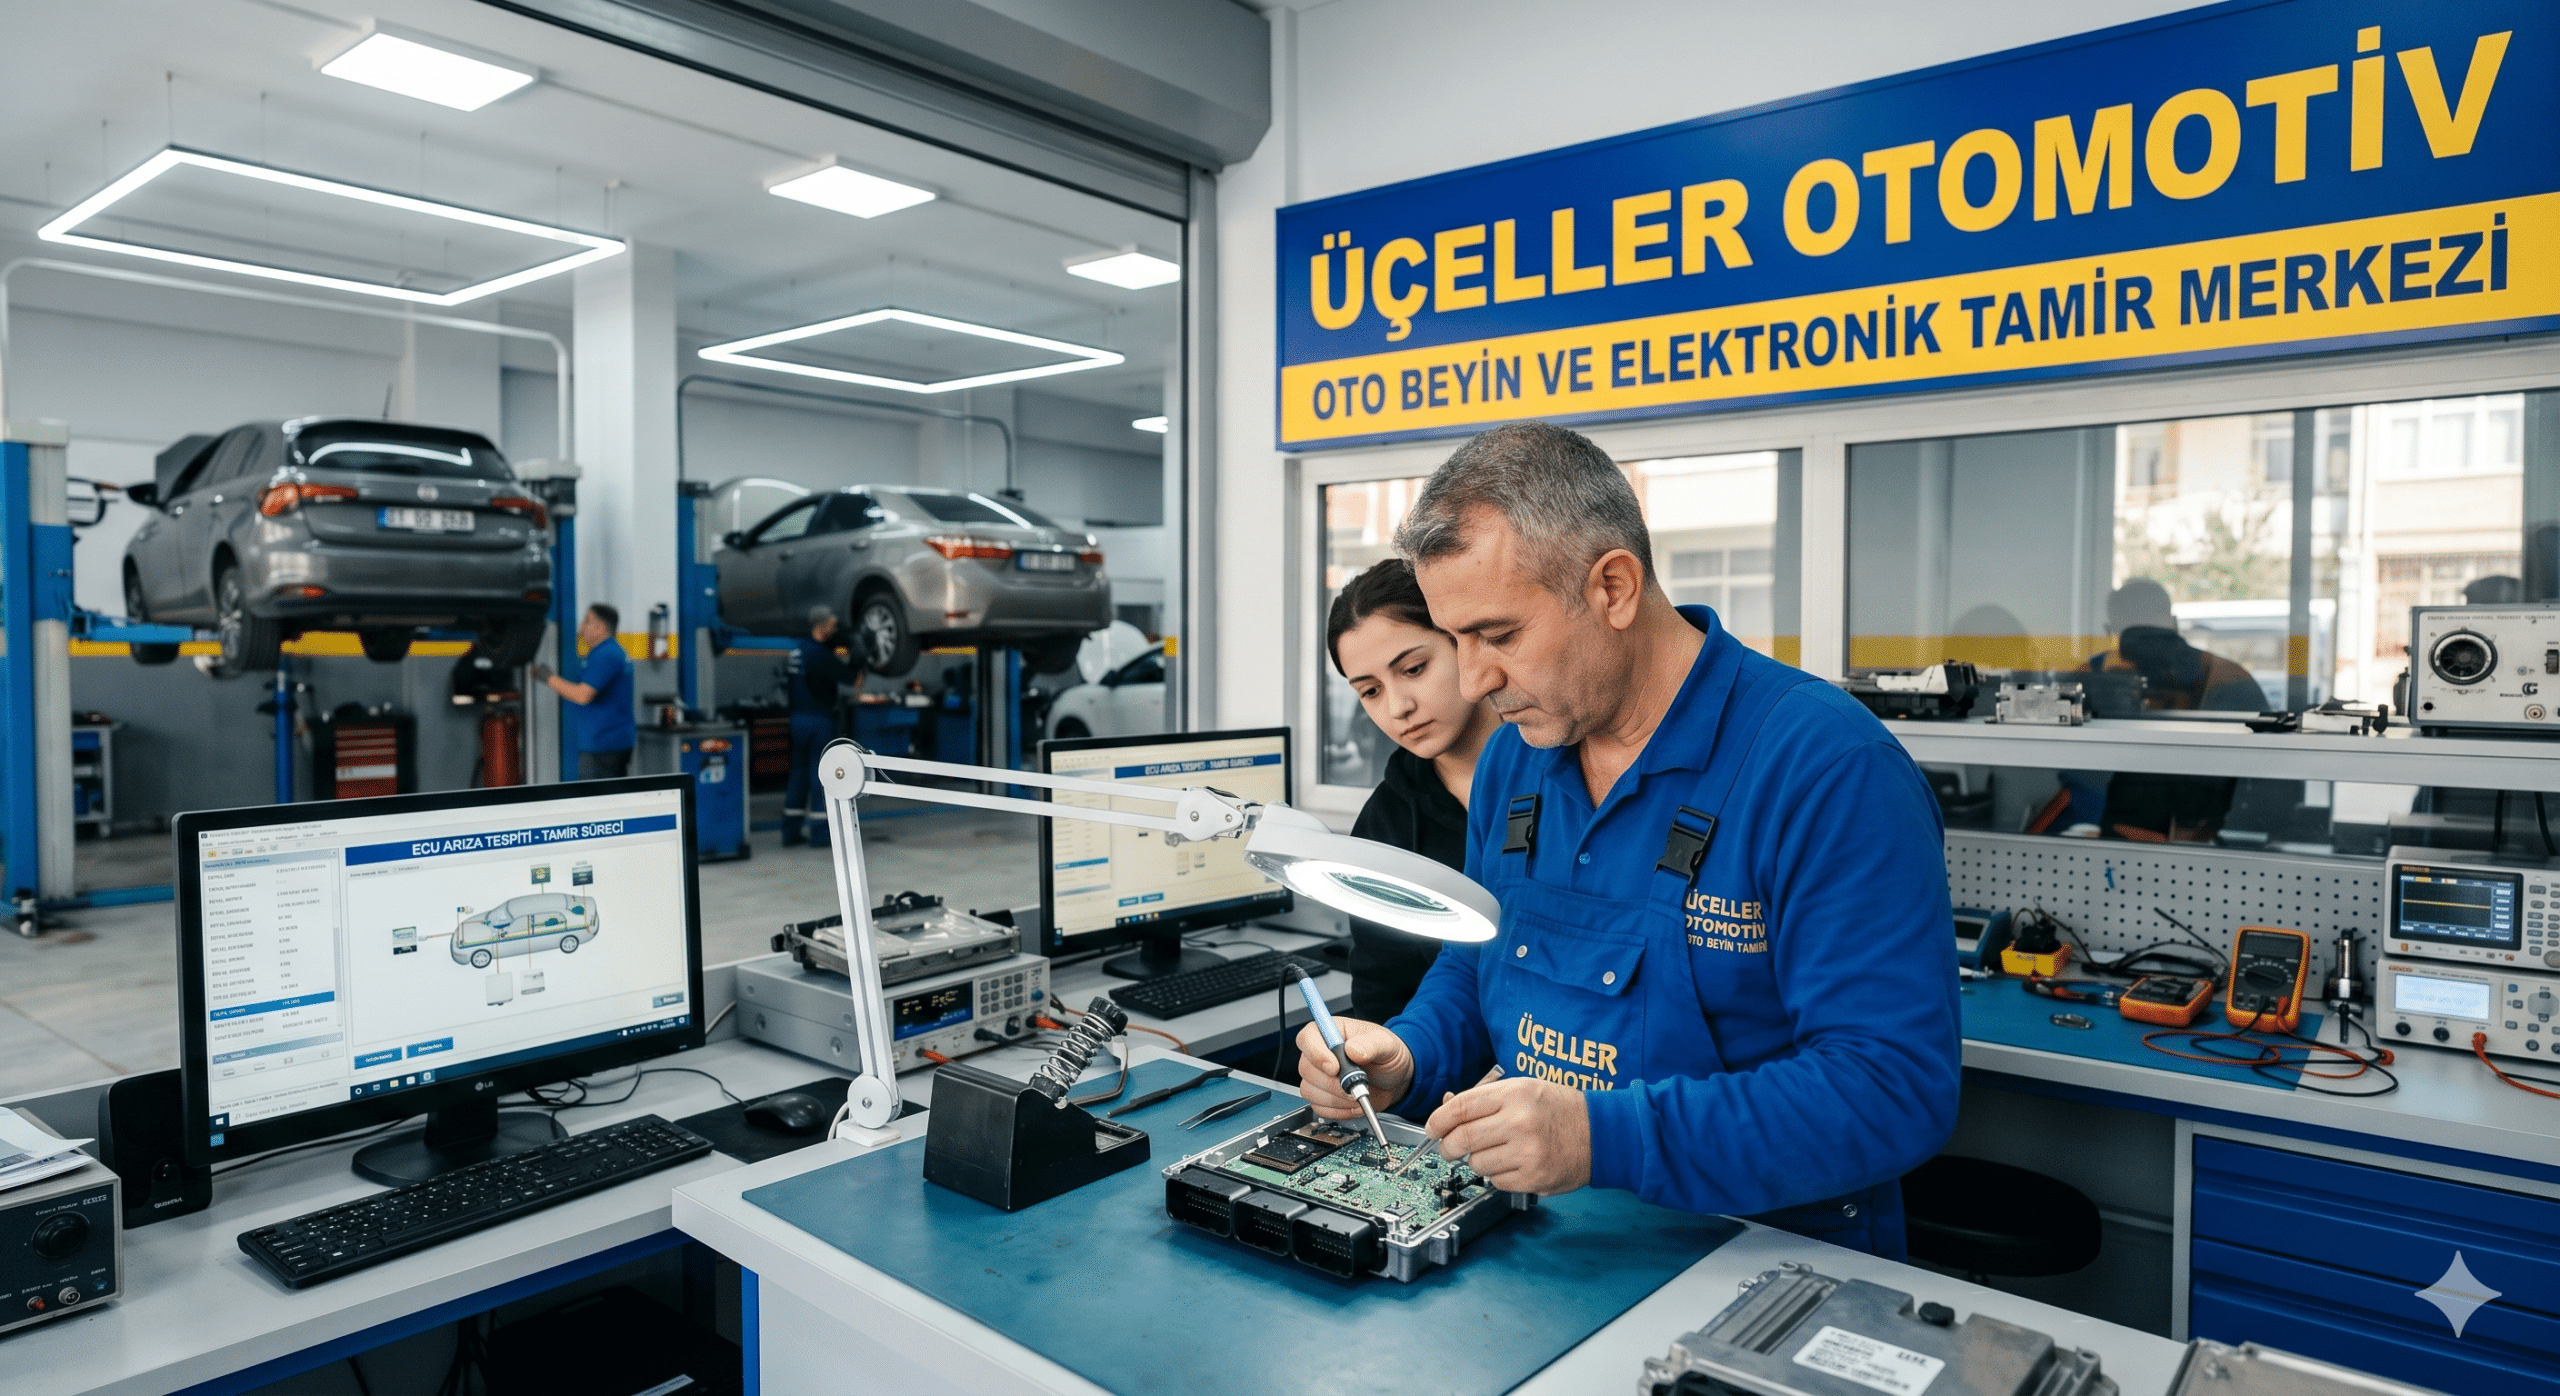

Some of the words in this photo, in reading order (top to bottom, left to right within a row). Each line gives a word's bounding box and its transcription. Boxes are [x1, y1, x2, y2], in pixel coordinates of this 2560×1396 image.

[1310, 178, 1753, 341] ÜÇELLER
[1783, 25, 2513, 257] OTOMOTİV
[1312, 373, 1387, 421] OTO
[1400, 348, 1522, 411] BEYİN
[1537, 346, 1593, 396] VE
[1610, 294, 1942, 389] ELEKTRONİK
[1961, 267, 2155, 350] TAMİR
[2180, 212, 2509, 326] MERKEZİ
[412, 841, 440, 856] ECU
[443, 837, 483, 851] ARIZA
[484, 829, 532, 848] TESPİTİ
[541, 825, 579, 841] TAMİR
[581, 820, 624, 838] SÜRECİ
[1685, 888, 1763, 920] ÜÇELLER
[1706, 937, 1734, 952] BEYİN
[1517, 1012, 1618, 1076] ÜÇELLER
